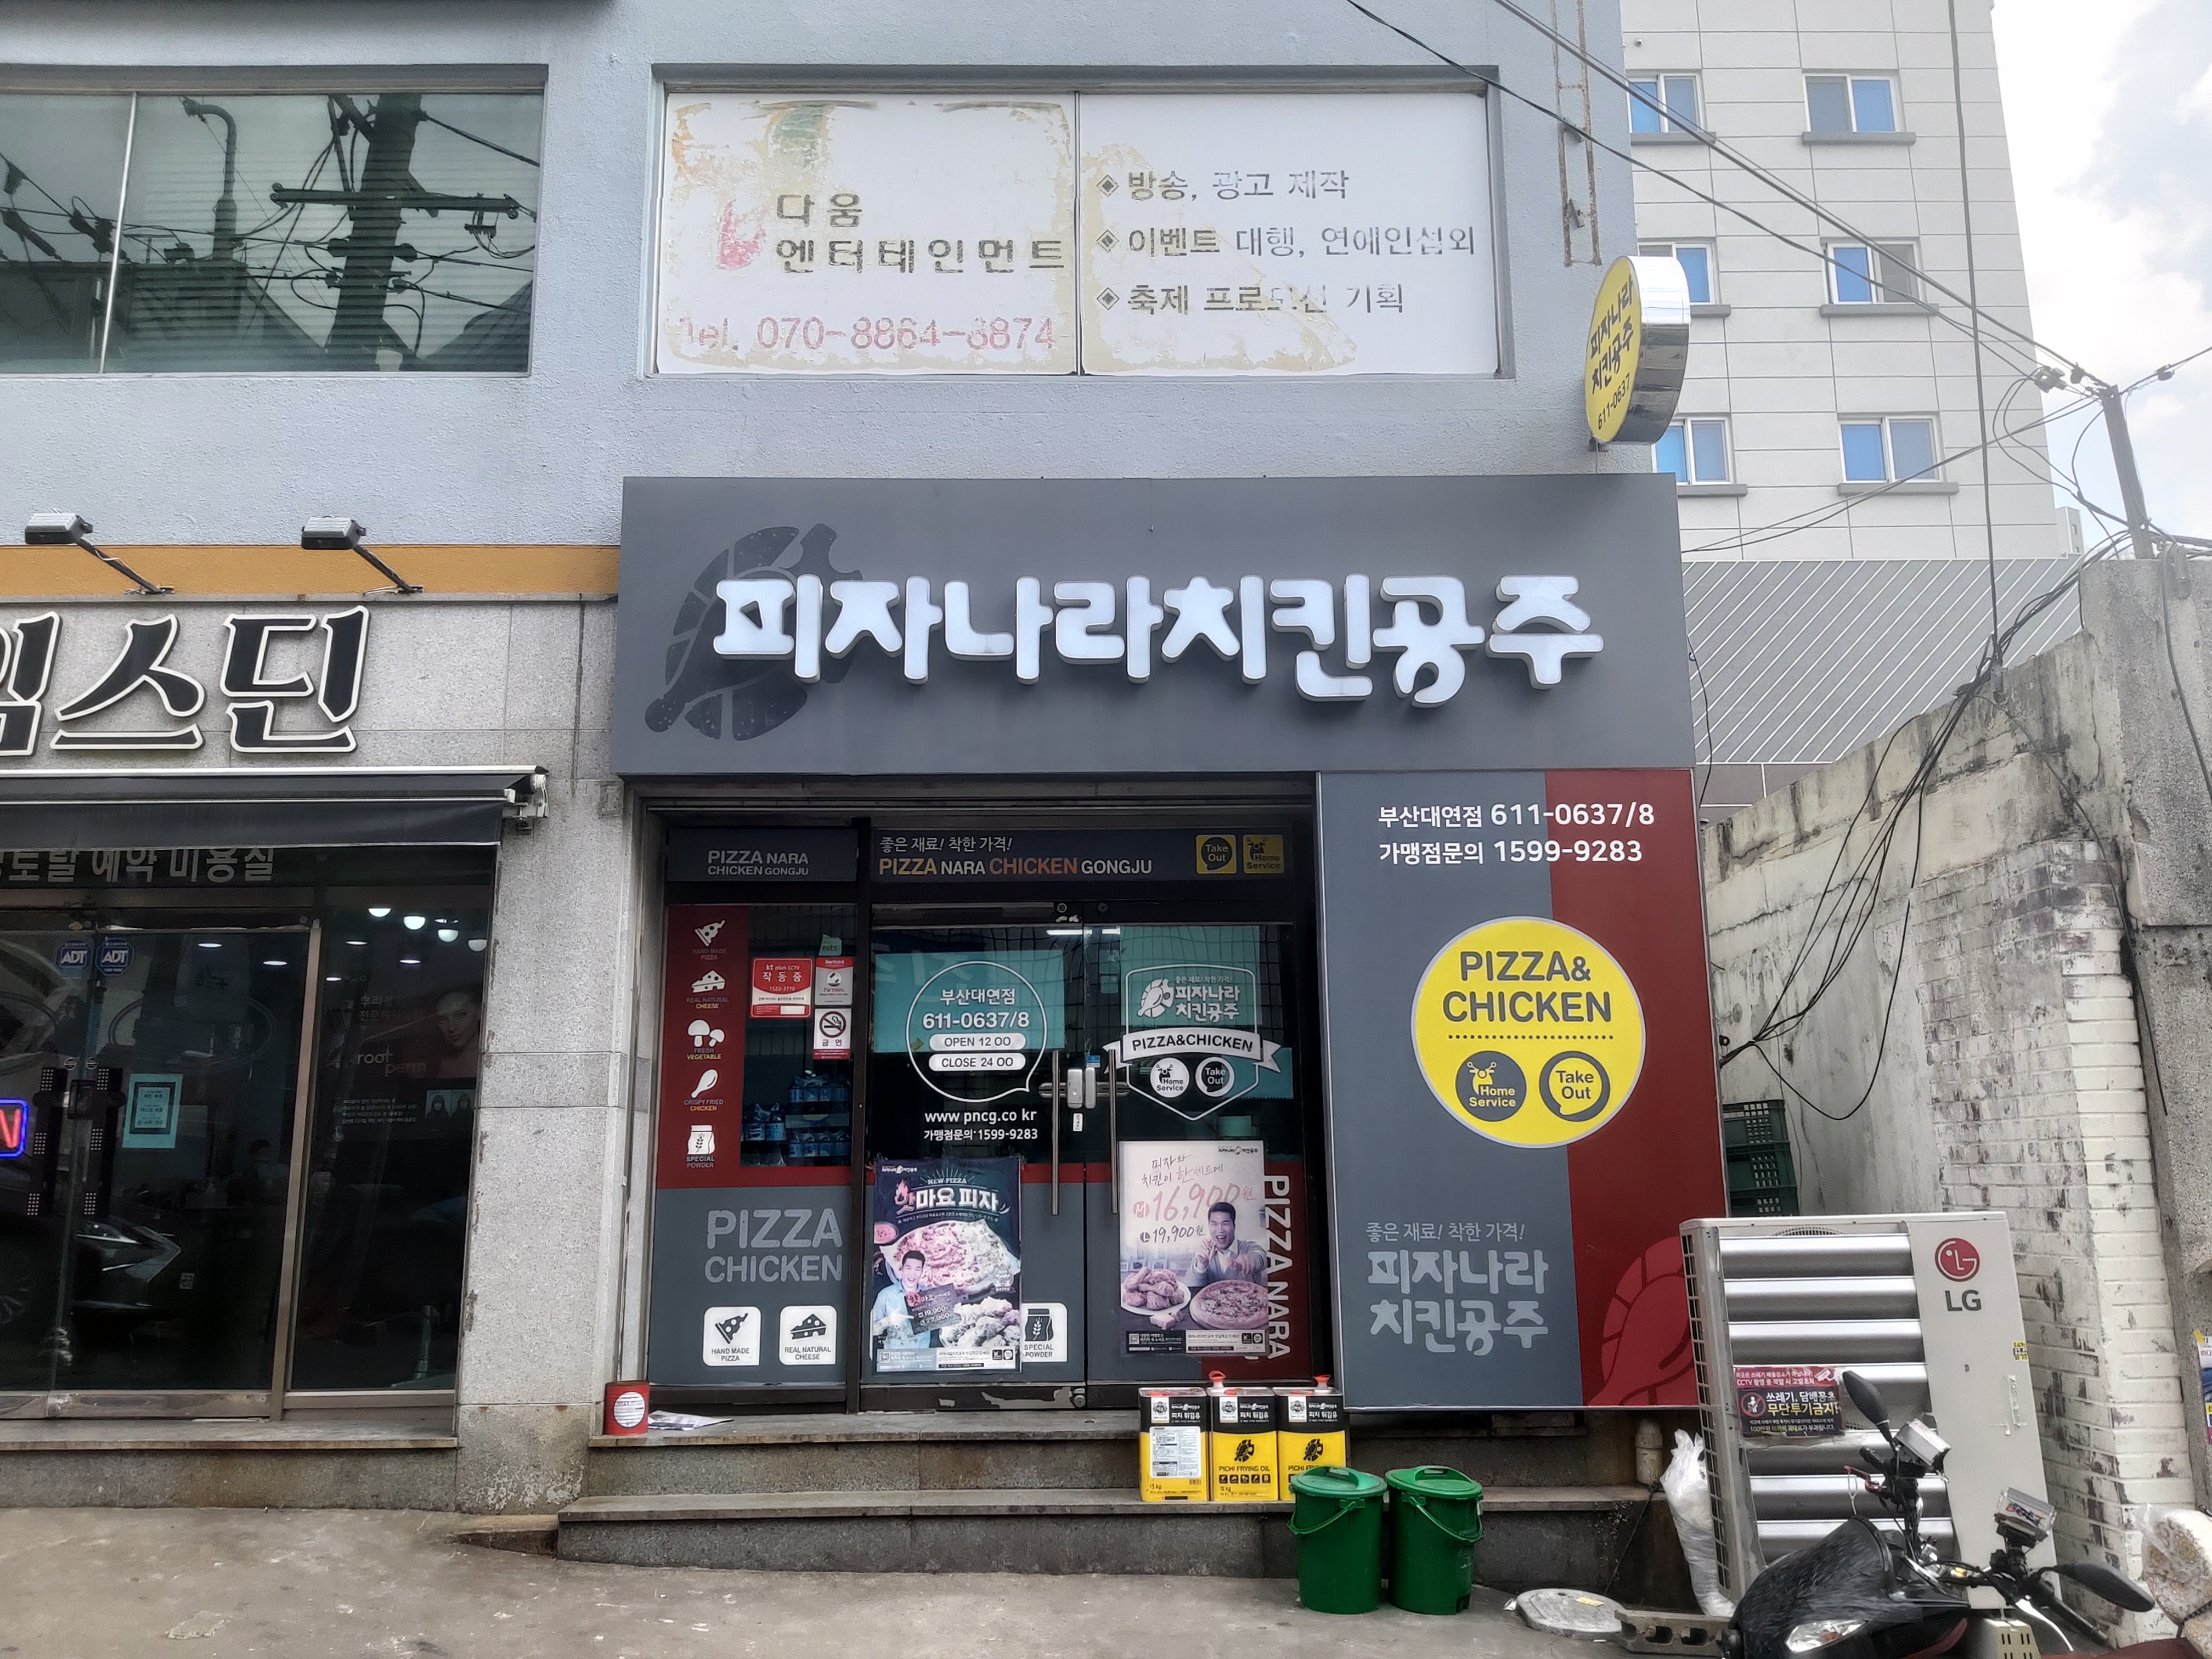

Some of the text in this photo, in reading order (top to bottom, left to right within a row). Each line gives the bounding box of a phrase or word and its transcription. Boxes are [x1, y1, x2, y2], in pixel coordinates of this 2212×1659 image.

[1128, 170, 1349, 201] 방송, 광고 제작
[776, 193, 863, 228] 다움
[1128, 227, 1221, 257] 이벤트
[1127, 284, 1189, 315] 축제
[1345, 283, 1404, 313] 기획
[1590, 274, 1634, 360] 피자나라
[1592, 314, 1634, 395] 치킨공주
[1598, 373, 1631, 431] 611-0637
[713, 573, 1606, 709] 피자나라치킨공주
[1378, 802, 1655, 828] 부산대연점 611-0637/8
[879, 836, 1013, 854] 좋은 재료! 착한 가격!
[1204, 844, 1229, 854] Take
[1379, 840, 1643, 865] 가맹점문의 1599-9283
[169, 848, 273, 883] 미용실
[707, 850, 809, 865] PIZZA NARA
[879, 857, 1153, 876] PIZZA NARA CHICKEN GONGJU
[1207, 853, 1227, 863] Out
[1245, 861, 1281, 871] Service
[1254, 854, 1280, 862] Home
[707, 865, 809, 876] CHICKEN GONGJU
[60, 950, 88, 964] ADT
[101, 950, 128, 963] ADT
[1459, 950, 1592, 982] PIZZA&
[939, 988, 1017, 1006] 부산대연점
[1175, 985, 1240, 1002] 피자나라
[1175, 1002, 1240, 1023] 치킨공주
[1442, 991, 1612, 1023] CHICKEN
[922, 1012, 1030, 1030] 611-0637/8
[944, 1037, 975, 1047] OPEN
[1132, 1034, 1253, 1052] PIZZA&CHICKEN
[941, 1057, 977, 1068] CLOSE
[1204, 1067, 1227, 1076] Take
[1207, 1076, 1224, 1085] Out
[1555, 1070, 1595, 1084] Take
[1479, 1085, 1516, 1097] Home
[1561, 1086, 1592, 1100] Out
[1469, 1097, 1516, 1108] Service
[1141, 1172, 1172, 1189] 치킨이
[958, 1187, 999, 1212] 피자
[706, 1208, 843, 1250] PIZZA
[1365, 1221, 1526, 1243] 좋은 재료! 착한 가격!
[704, 1254, 843, 1284] CHICKEN
[1265, 1175, 1293, 1360] PIZZA NARA
[1367, 1249, 1550, 1295] 피자나라
[1944, 1289, 1982, 1312] LG
[1369, 1298, 1549, 1357] 치킨공주
